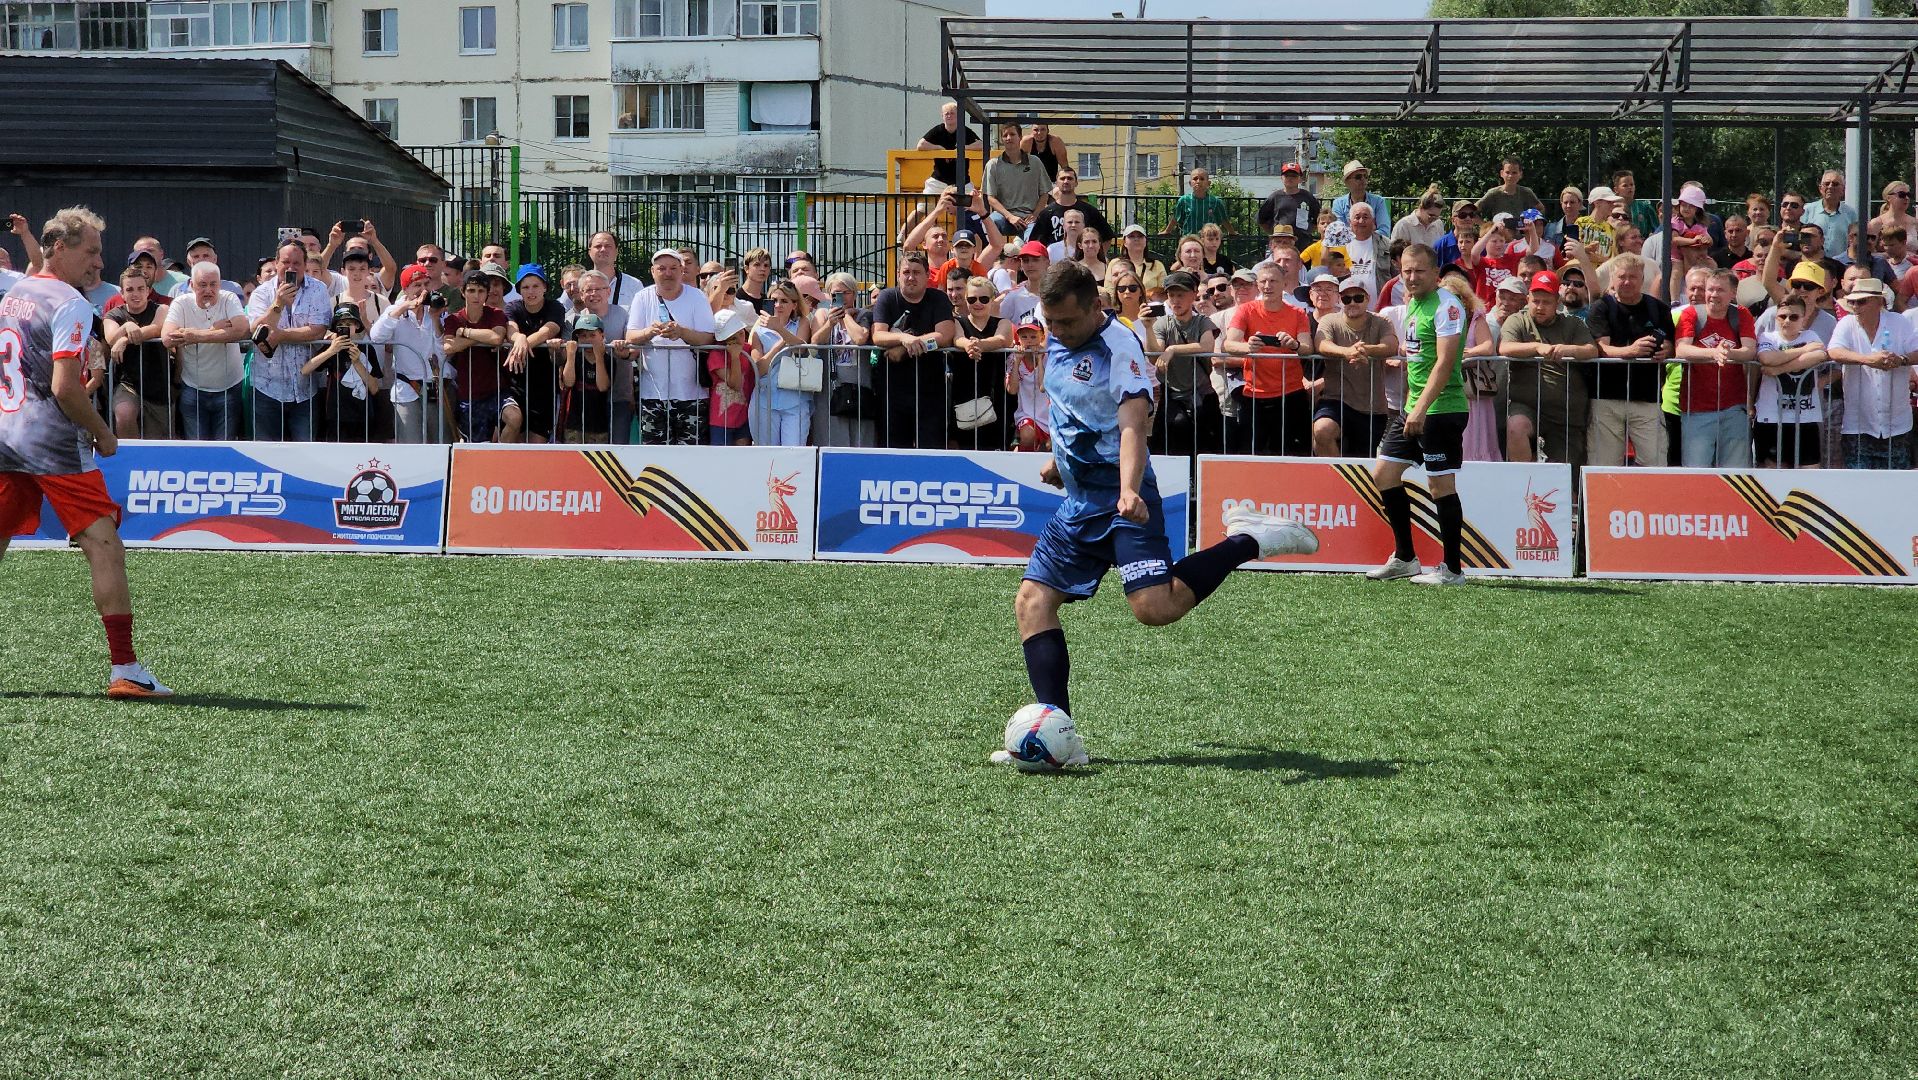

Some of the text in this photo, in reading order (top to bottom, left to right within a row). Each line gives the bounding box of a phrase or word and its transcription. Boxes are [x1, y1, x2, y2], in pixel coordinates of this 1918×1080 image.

[128, 470, 283, 494] МОСОБЛ
[860, 479, 1020, 505] МОСОБЛ
[127, 493, 249, 515] СПОРТ
[341, 504, 399, 516] МАТЧ ЛЕГЕНД
[470, 486, 602, 516] 80 ПОБЕДА!
[756, 511, 780, 530] 80
[859, 503, 985, 528] СПОРТ
[1609, 510, 1748, 540] 80 ПОБЕДА!
[755, 533, 799, 545] ПОБЕДА!
[1516, 527, 1539, 548] 80
[1516, 551, 1559, 562] ПОБЕДА!
[1121, 567, 1156, 584] ПОРТ
